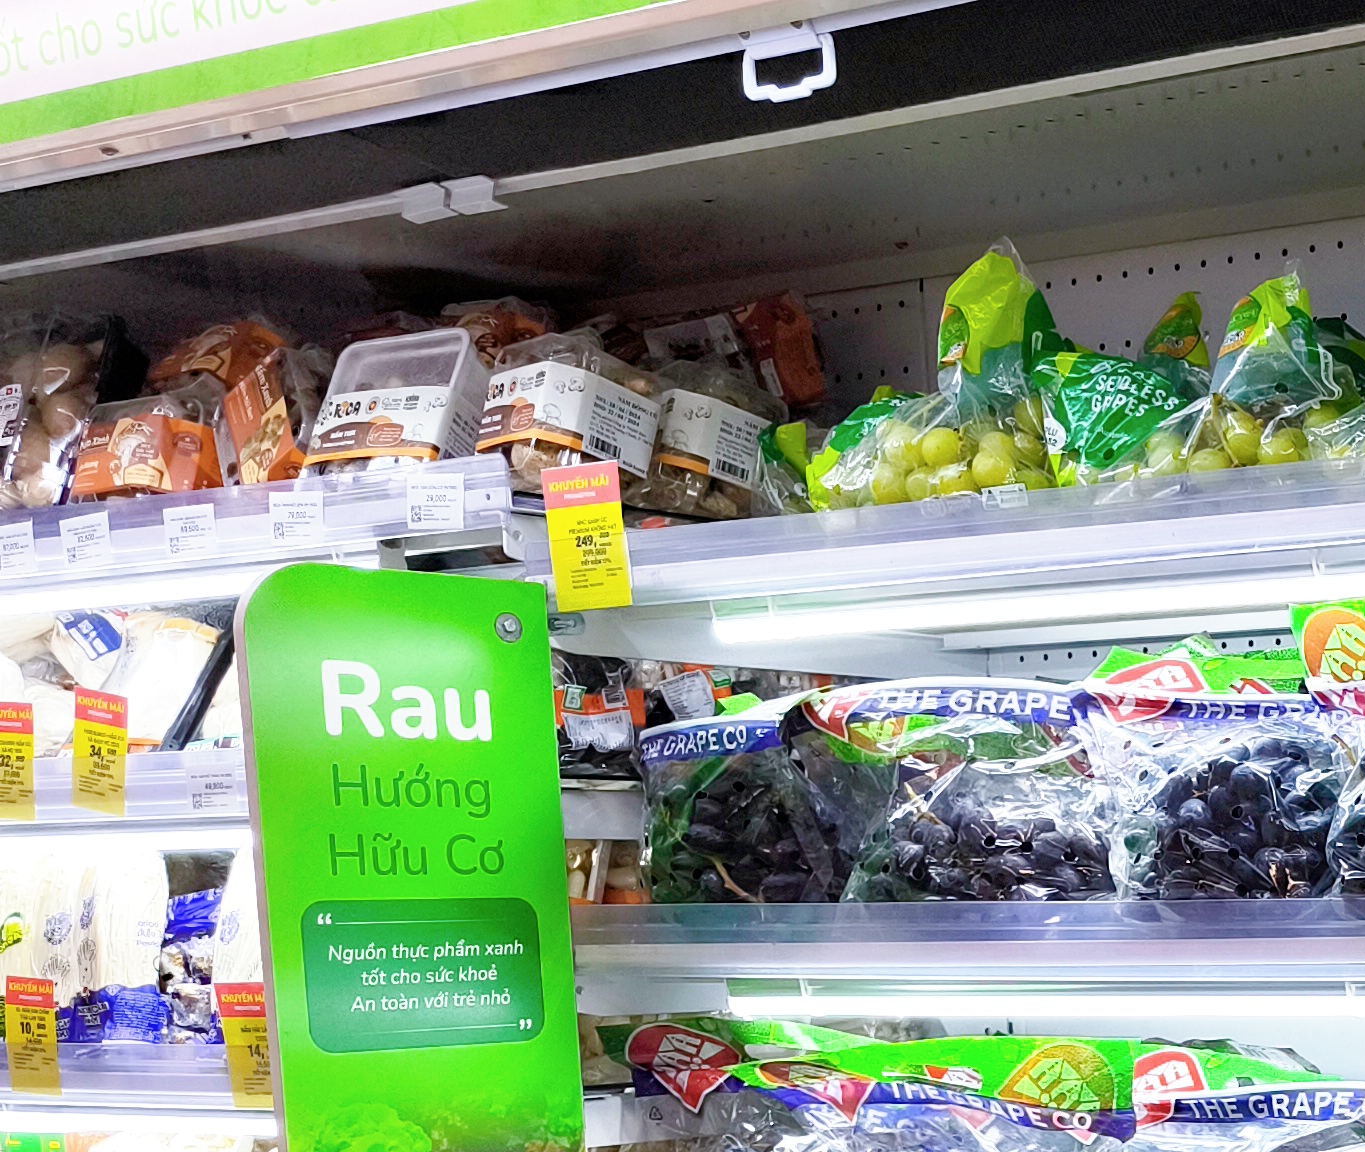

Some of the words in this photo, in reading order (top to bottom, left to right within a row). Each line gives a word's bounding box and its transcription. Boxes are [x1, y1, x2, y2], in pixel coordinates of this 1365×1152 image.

[321, 659, 492, 742] Rau
[332, 763, 491, 818] Hướng
[329, 833, 428, 876] Hữu
[446, 833, 504, 876] Cơ
[329, 942, 386, 964] Nguồn
[392, 943, 429, 962] thực
[434, 939, 480, 960] phẩm
[485, 940, 523, 955] xanh
[361, 967, 386, 985] tốt
[391, 969, 421, 985] cho
[426, 967, 454, 983] sức
[459, 964, 498, 981] khoẻ
[351, 996, 375, 1012] An
[381, 993, 419, 1010] toàn
[424, 993, 448, 1008] với
[453, 990, 475, 1007] trẻ
[480, 988, 511, 1005] nhỏ
